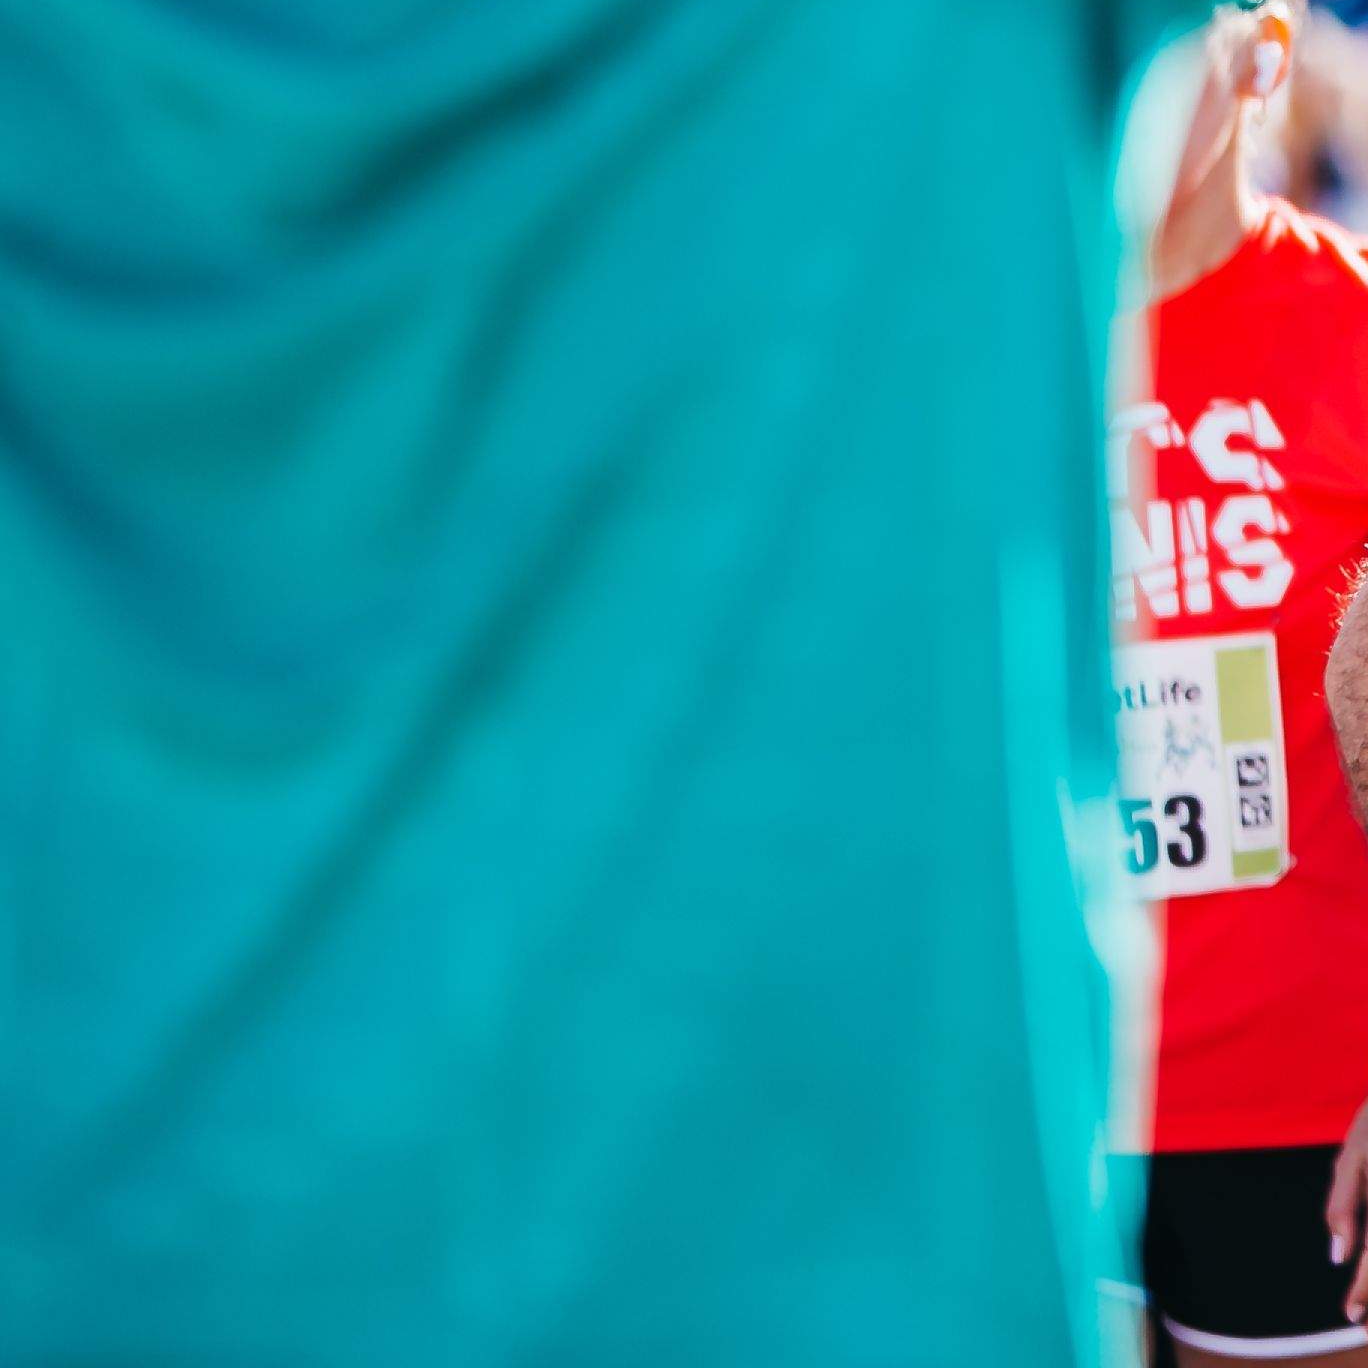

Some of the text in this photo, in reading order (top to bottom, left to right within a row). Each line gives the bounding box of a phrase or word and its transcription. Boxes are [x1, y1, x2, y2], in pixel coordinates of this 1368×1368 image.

[1106, 398, 1286, 491] TS
[1109, 495, 1294, 620] NIS
[1112, 677, 1202, 711] tLife
[1118, 795, 1207, 874] 53
